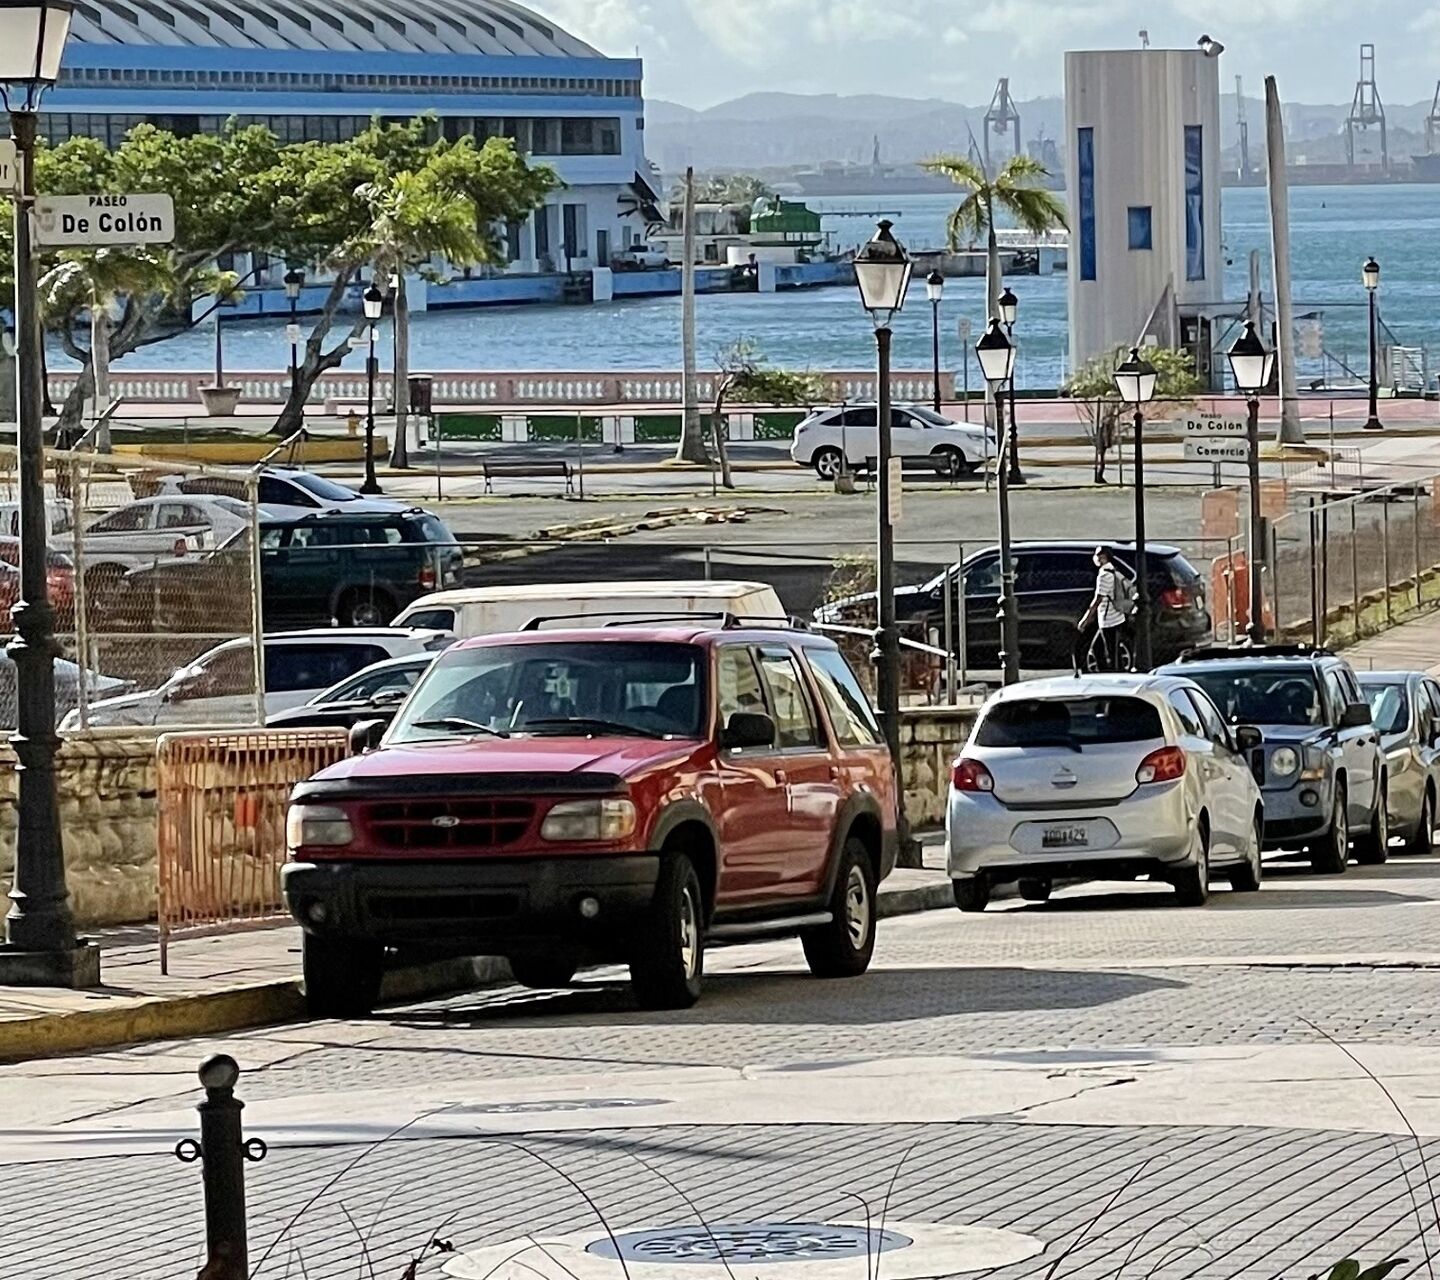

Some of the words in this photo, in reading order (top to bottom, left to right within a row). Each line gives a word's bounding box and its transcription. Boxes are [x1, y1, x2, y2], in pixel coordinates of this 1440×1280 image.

[88, 195, 127, 207] PASEO
[62, 214, 89, 233] De
[99, 211, 162, 233] Colón
[1187, 421, 1203, 430] De
[1196, 446, 1245, 457] Comercio
